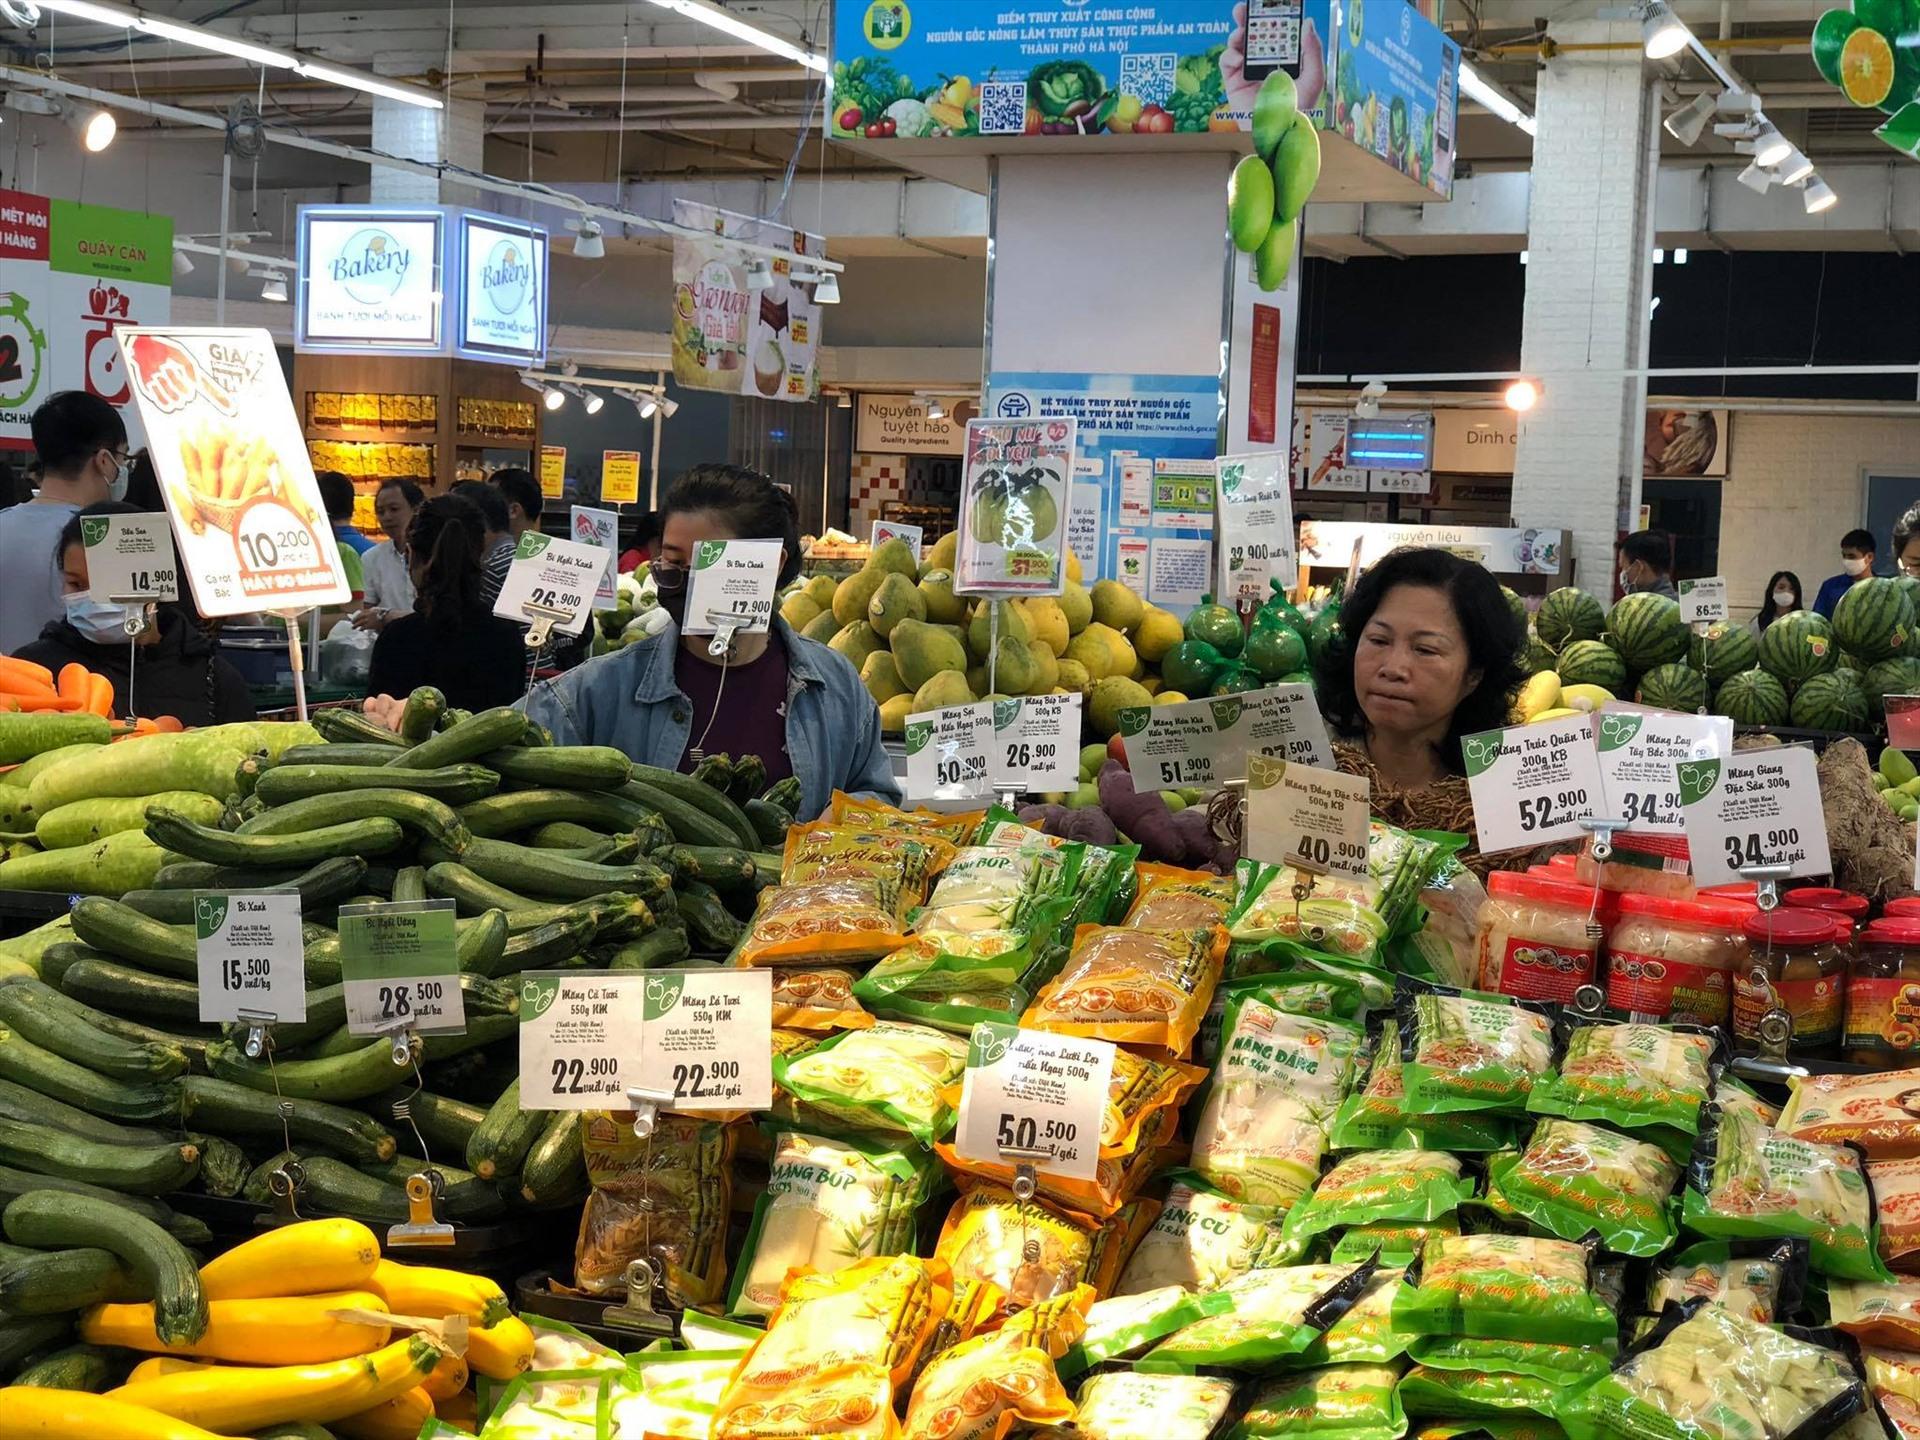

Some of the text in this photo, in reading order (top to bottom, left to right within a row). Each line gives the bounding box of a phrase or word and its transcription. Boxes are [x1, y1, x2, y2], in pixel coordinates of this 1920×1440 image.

[997, 8, 1155, 25] ĐIỂM TRUY XUẤT CÔNG CỘNG
[926, 29, 963, 43] NGUỒN
[965, 27, 985, 41] GỐC
[988, 28, 1018, 41] NÔNG
[1021, 27, 1047, 40] LÂM
[1081, 23, 1104, 38] SẢN
[1108, 25, 1137, 38] THỰC
[1140, 20, 1174, 36] PHẨM
[1177, 24, 1194, 34] AN
[1198, 22, 1230, 33] TOÀN
[1020, 39, 1129, 54] THÀNH PHỐ HÀ NỘI
[1, 207, 24, 225] MỆT
[4, 230, 37, 250] HÀNG
[334, 247, 411, 282] Bakery
[482, 260, 529, 289] Bakery
[1056, 397, 1086, 406] THỐNG
[1114, 397, 1138, 408] XUẤT
[1141, 398, 1171, 408] NGUỒN
[1173, 398, 1191, 409] GỐC
[1040, 407, 1064, 416] NÔNG
[1066, 408, 1086, 417] LÂM
[1116, 408, 1133, 419] SẢN
[1136, 410, 1161, 420] THỰC
[1164, 409, 1190, 420] PHẨM
[1077, 419, 1096, 429] PHỐ
[1099, 418, 1113, 429] HÀ
[1116, 419, 1133, 432] NỘI
[880, 436, 949, 445] Quality Ingredients
[1467, 430, 1503, 445] Dinh
[1035, 706, 1062, 717] 500g KB
[1260, 705, 1291, 718] 500g KB
[975, 716, 992, 728] 500g
[1182, 725, 1200, 738] 500g
[1492, 742, 1522, 757] Măng
[1524, 738, 1548, 751] Trúc
[1550, 733, 1577, 748] Quân
[1646, 734, 1671, 745] Măng
[1521, 750, 1568, 768] 300g KB
[1728, 764, 1783, 780] Măng Giang
[1285, 778, 1307, 793] Măng
[1724, 777, 1790, 796] Đặc Sản 300g
[1308, 796, 1345, 811] 500g KB
[1330, 860, 1368, 876] vnđ/gói
[248, 901, 267, 911] Xanh
[562, 988, 619, 1001] Măng Củ Tươi
[682, 994, 740, 1007] Măng Lá Tươi
[570, 1004, 590, 1016] 550g
[693, 1011, 713, 1024] 550g
[1233, 1033, 1319, 1076] MĂNG ĐẮNG
[1040, 1064, 1090, 1081] Ngay 500g
[1272, 1069, 1289, 1082] 500
[582, 1079, 621, 1096] vnđ/gói
[703, 1084, 742, 1099] vnđ/gói
[816, 1168, 857, 1191] BÚP
[1161, 1204, 1231, 1235] ĂNG CỦ
